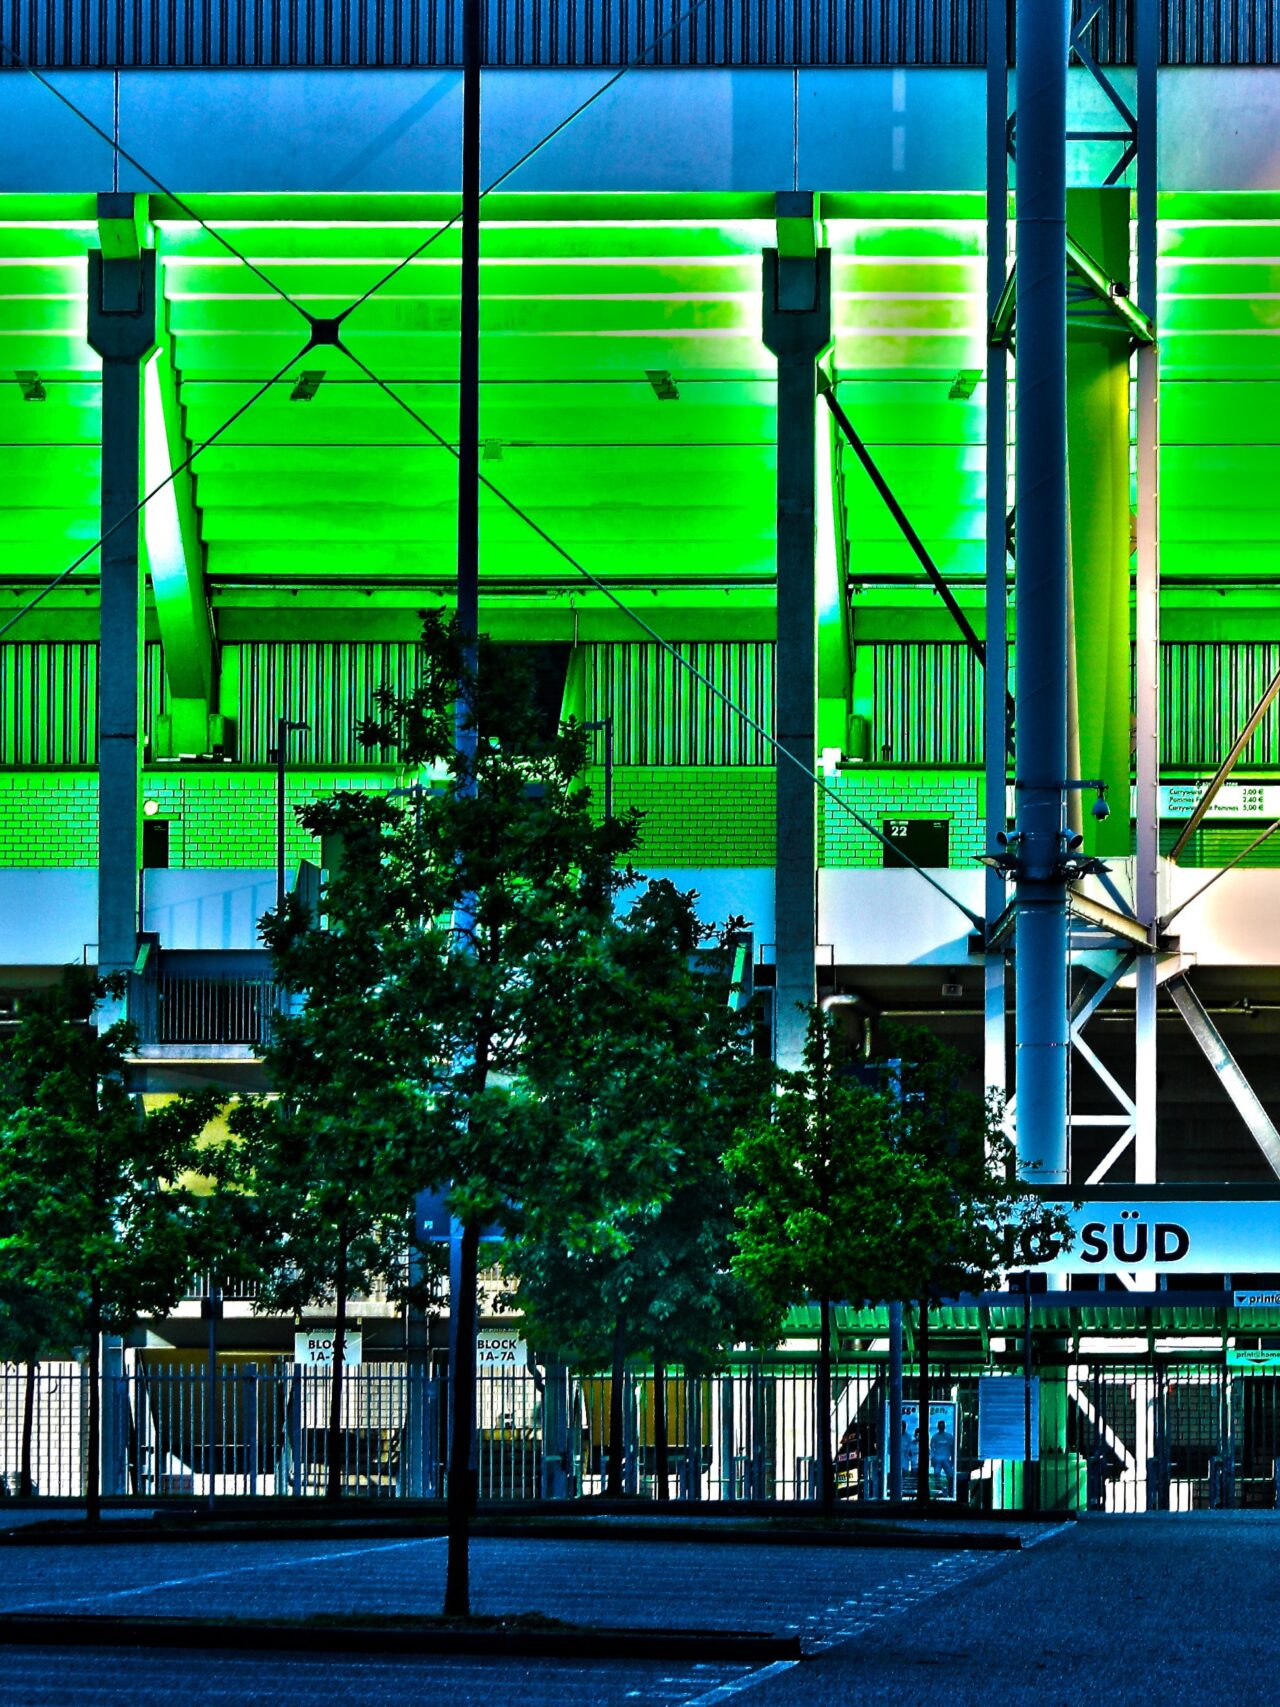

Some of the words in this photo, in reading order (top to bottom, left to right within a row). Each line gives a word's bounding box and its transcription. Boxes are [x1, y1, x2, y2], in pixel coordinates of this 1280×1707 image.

[890, 825, 908, 837] 22
[1080, 1210, 1190, 1263] SÜD
[477, 1339, 517, 1349] BLOCK
[479, 1351, 516, 1361] 1A-7A
